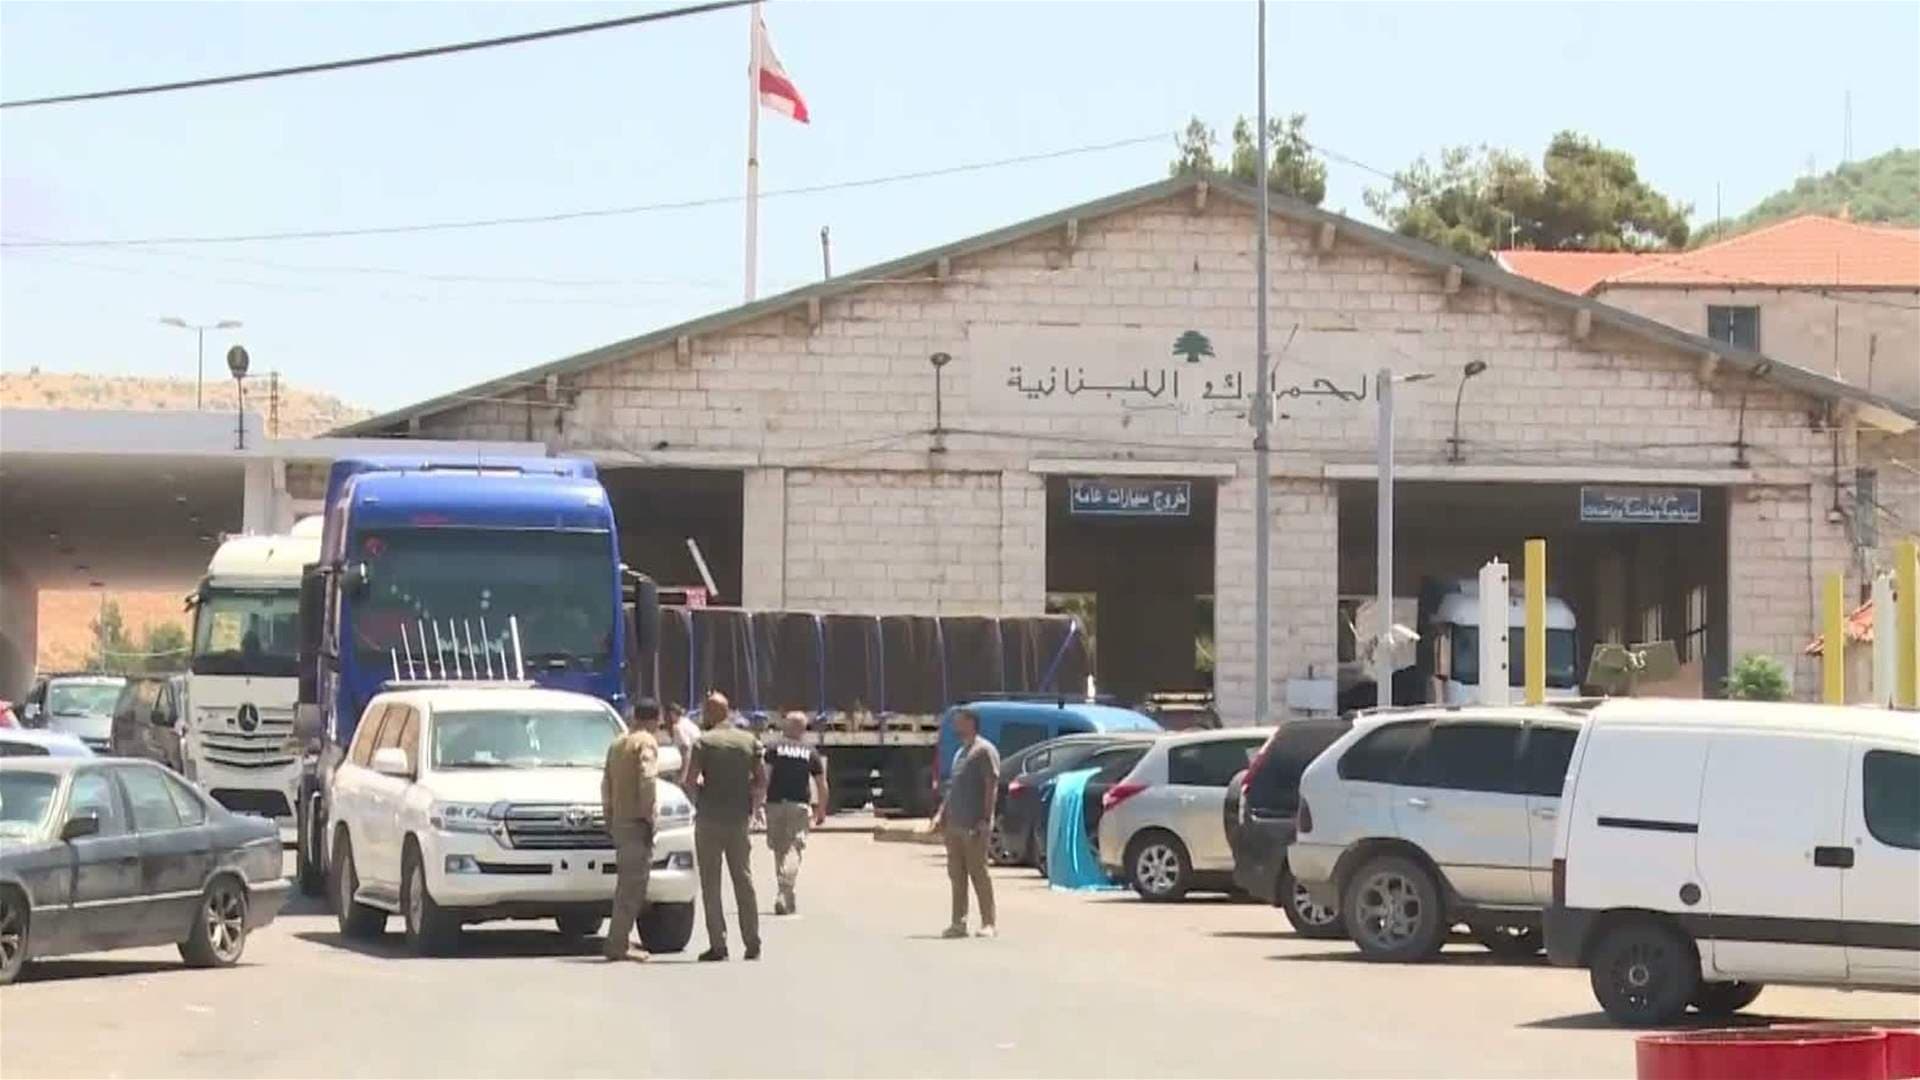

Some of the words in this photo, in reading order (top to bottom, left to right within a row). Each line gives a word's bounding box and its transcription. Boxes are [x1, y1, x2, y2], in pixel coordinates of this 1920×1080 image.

[1007, 366, 1178, 399] اللبنانية
[1075, 485, 1102, 504] عامة
[1107, 486, 1149, 508] سيارات
[1153, 486, 1186, 511] خروج
